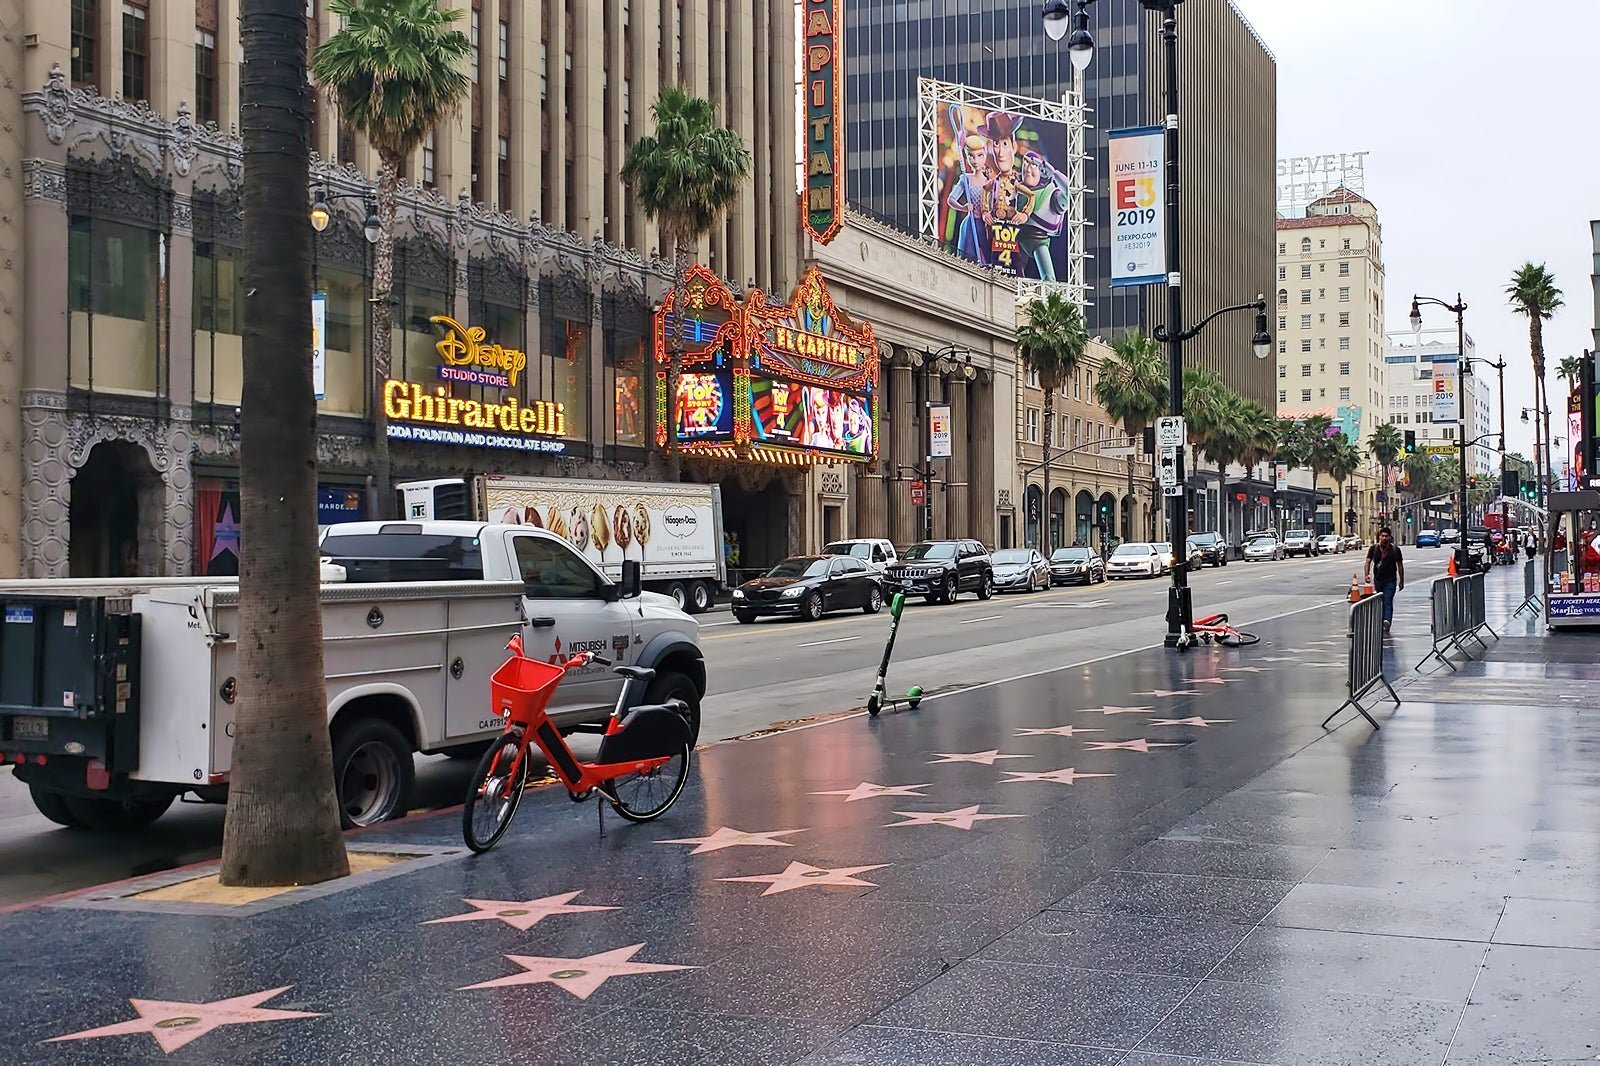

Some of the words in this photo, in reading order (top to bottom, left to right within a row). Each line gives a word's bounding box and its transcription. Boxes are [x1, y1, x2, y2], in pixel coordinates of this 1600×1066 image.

[807, 0, 832, 212] APITAN
[1115, 163, 1135, 172] JUNE
[1138, 160, 1158, 169] 11-13
[1117, 177, 1156, 210] E3
[1117, 208, 1156, 226] 2019
[992, 225, 1020, 242] TOY
[1117, 232, 1157, 242] E3EXPO.COM
[994, 242, 1017, 250] STORY
[1124, 242, 1150, 250] #E32019
[998, 250, 1012, 266] 4
[777, 327, 794, 350] EL
[797, 333, 857, 365] CAPITAN
[441, 367, 477, 382] STUDIO
[478, 373, 509, 387] STORE
[684, 383, 716, 400] TOY
[1436, 380, 1454, 392] E3
[384, 379, 567, 437] Ghirardelli
[692, 407, 707, 424] 4
[412, 427, 464, 444] FOUNTAIN
[463, 433, 485, 446] AND
[485, 436, 541, 450] CHOCOLATE
[541, 441, 565, 452] SHOP
[569, 640, 607, 653] MITSUBISHI
[479, 720, 489, 729] CA
